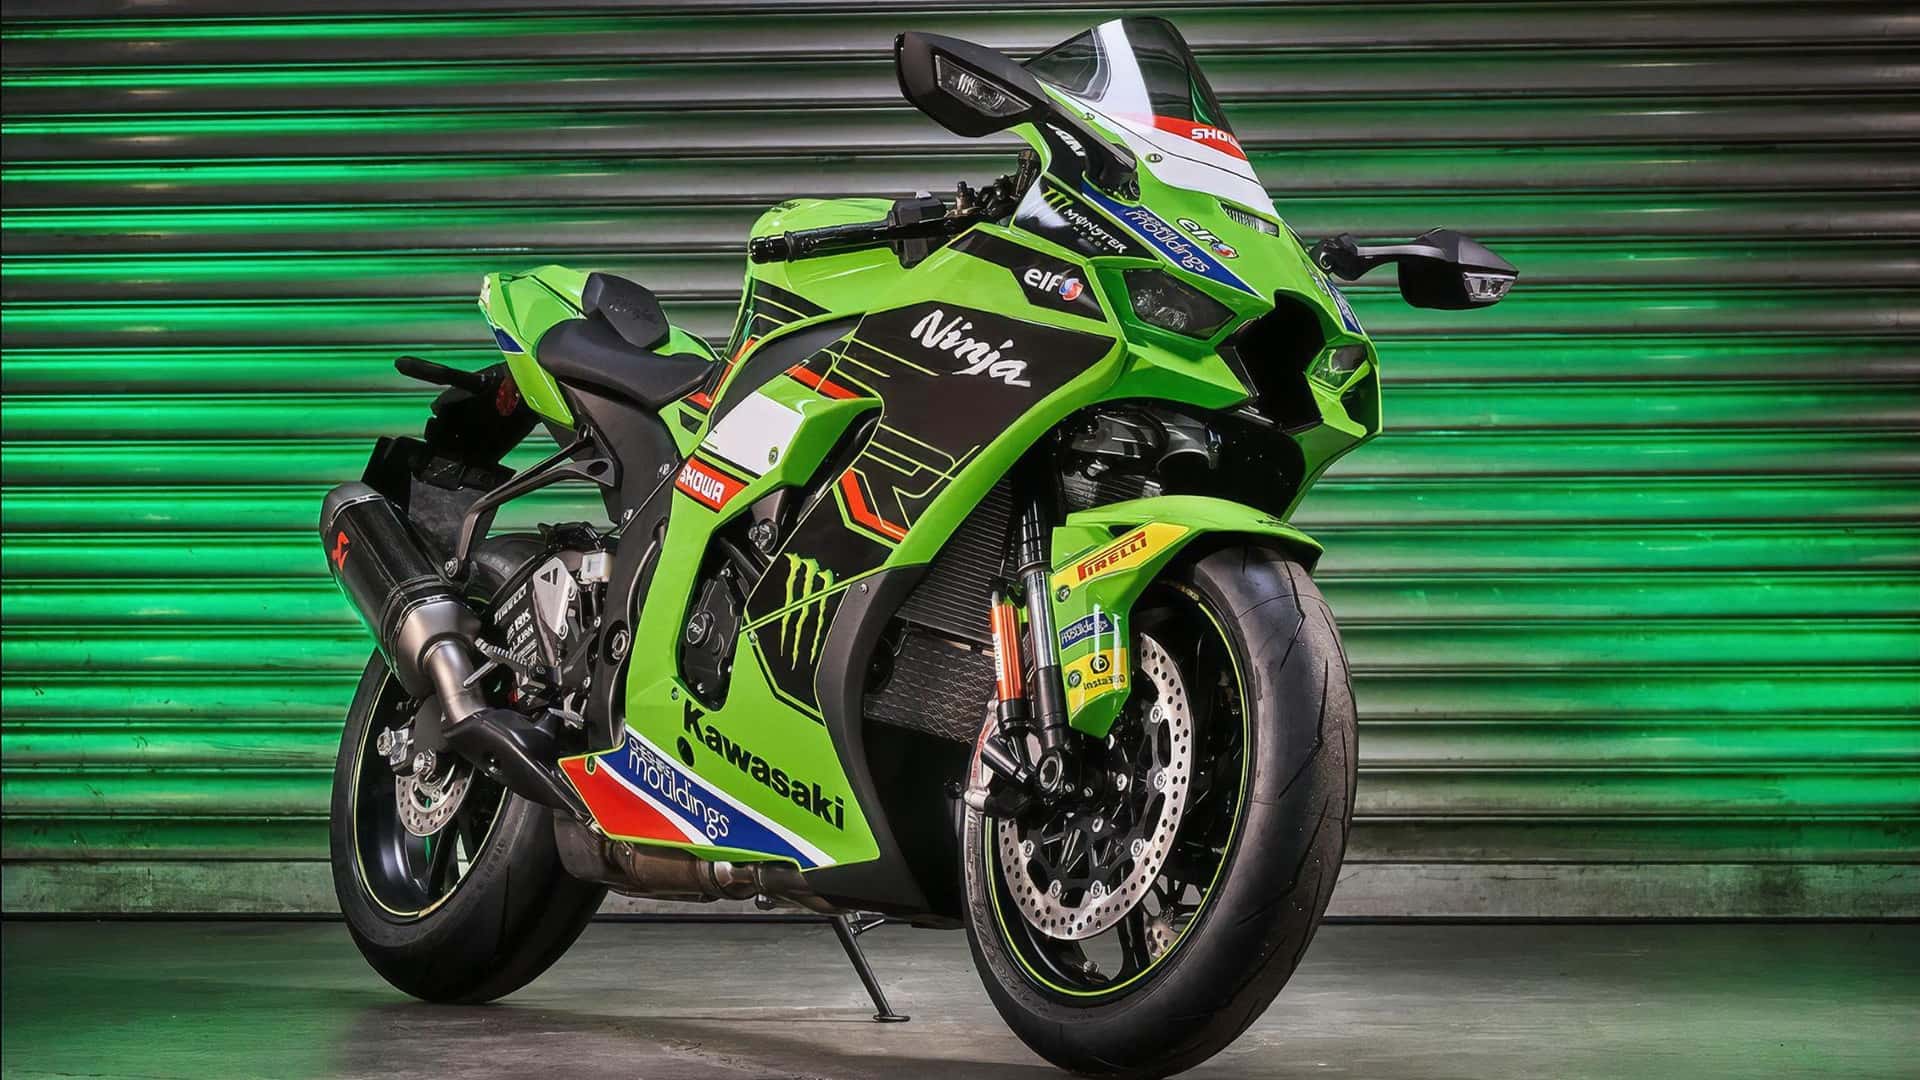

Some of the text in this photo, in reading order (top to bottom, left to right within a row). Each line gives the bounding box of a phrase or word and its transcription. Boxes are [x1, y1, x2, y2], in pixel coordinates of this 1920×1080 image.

[1063, 209, 1127, 254] MONSTER
[1177, 217, 1217, 246] elf
[1023, 268, 1066, 293] elf
[910, 309, 1031, 387] Ninja
[679, 463, 725, 504] SHOWA
[1077, 531, 1148, 582] PIRELLI
[684, 699, 844, 831] Kawasaki
[628, 748, 730, 840] mouldings
